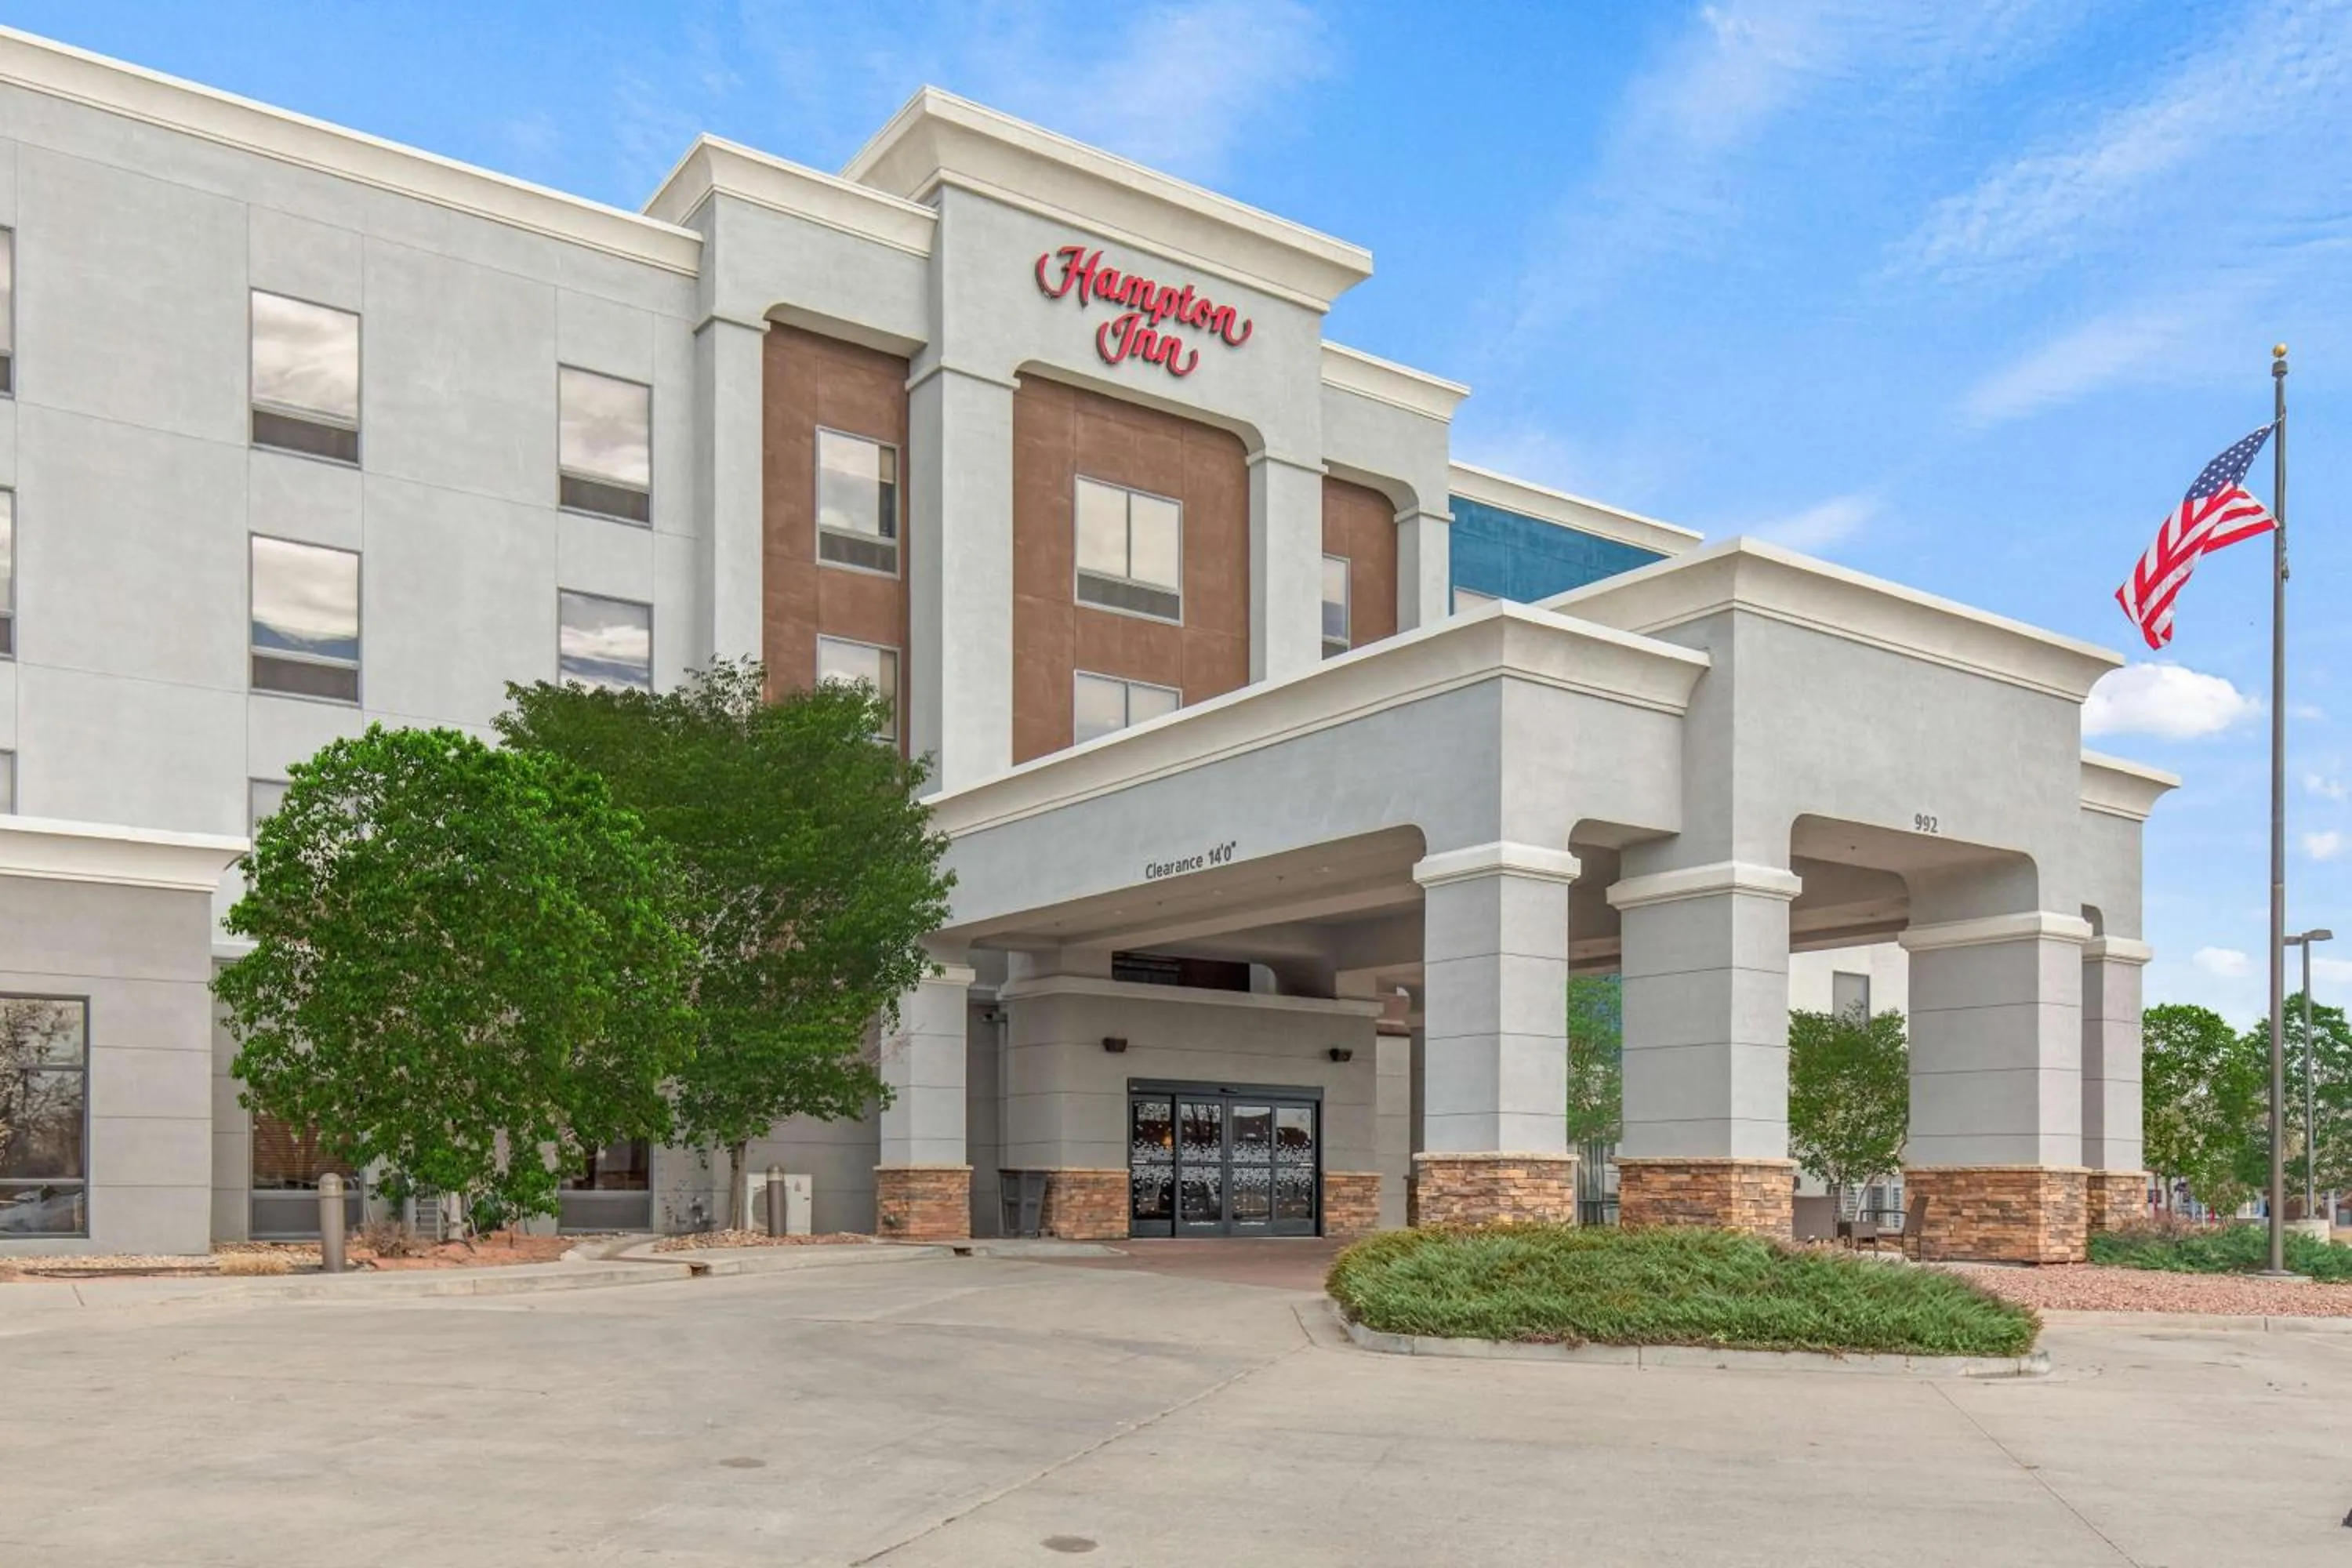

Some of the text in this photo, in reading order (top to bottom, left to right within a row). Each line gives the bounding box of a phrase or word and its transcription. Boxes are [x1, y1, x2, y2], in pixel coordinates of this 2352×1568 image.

[1035, 245, 1252, 347] Hampton
[1096, 312, 1199, 376] Inn
[1915, 813, 1938, 833] 992
[1145, 855, 1203, 879] Clearance
